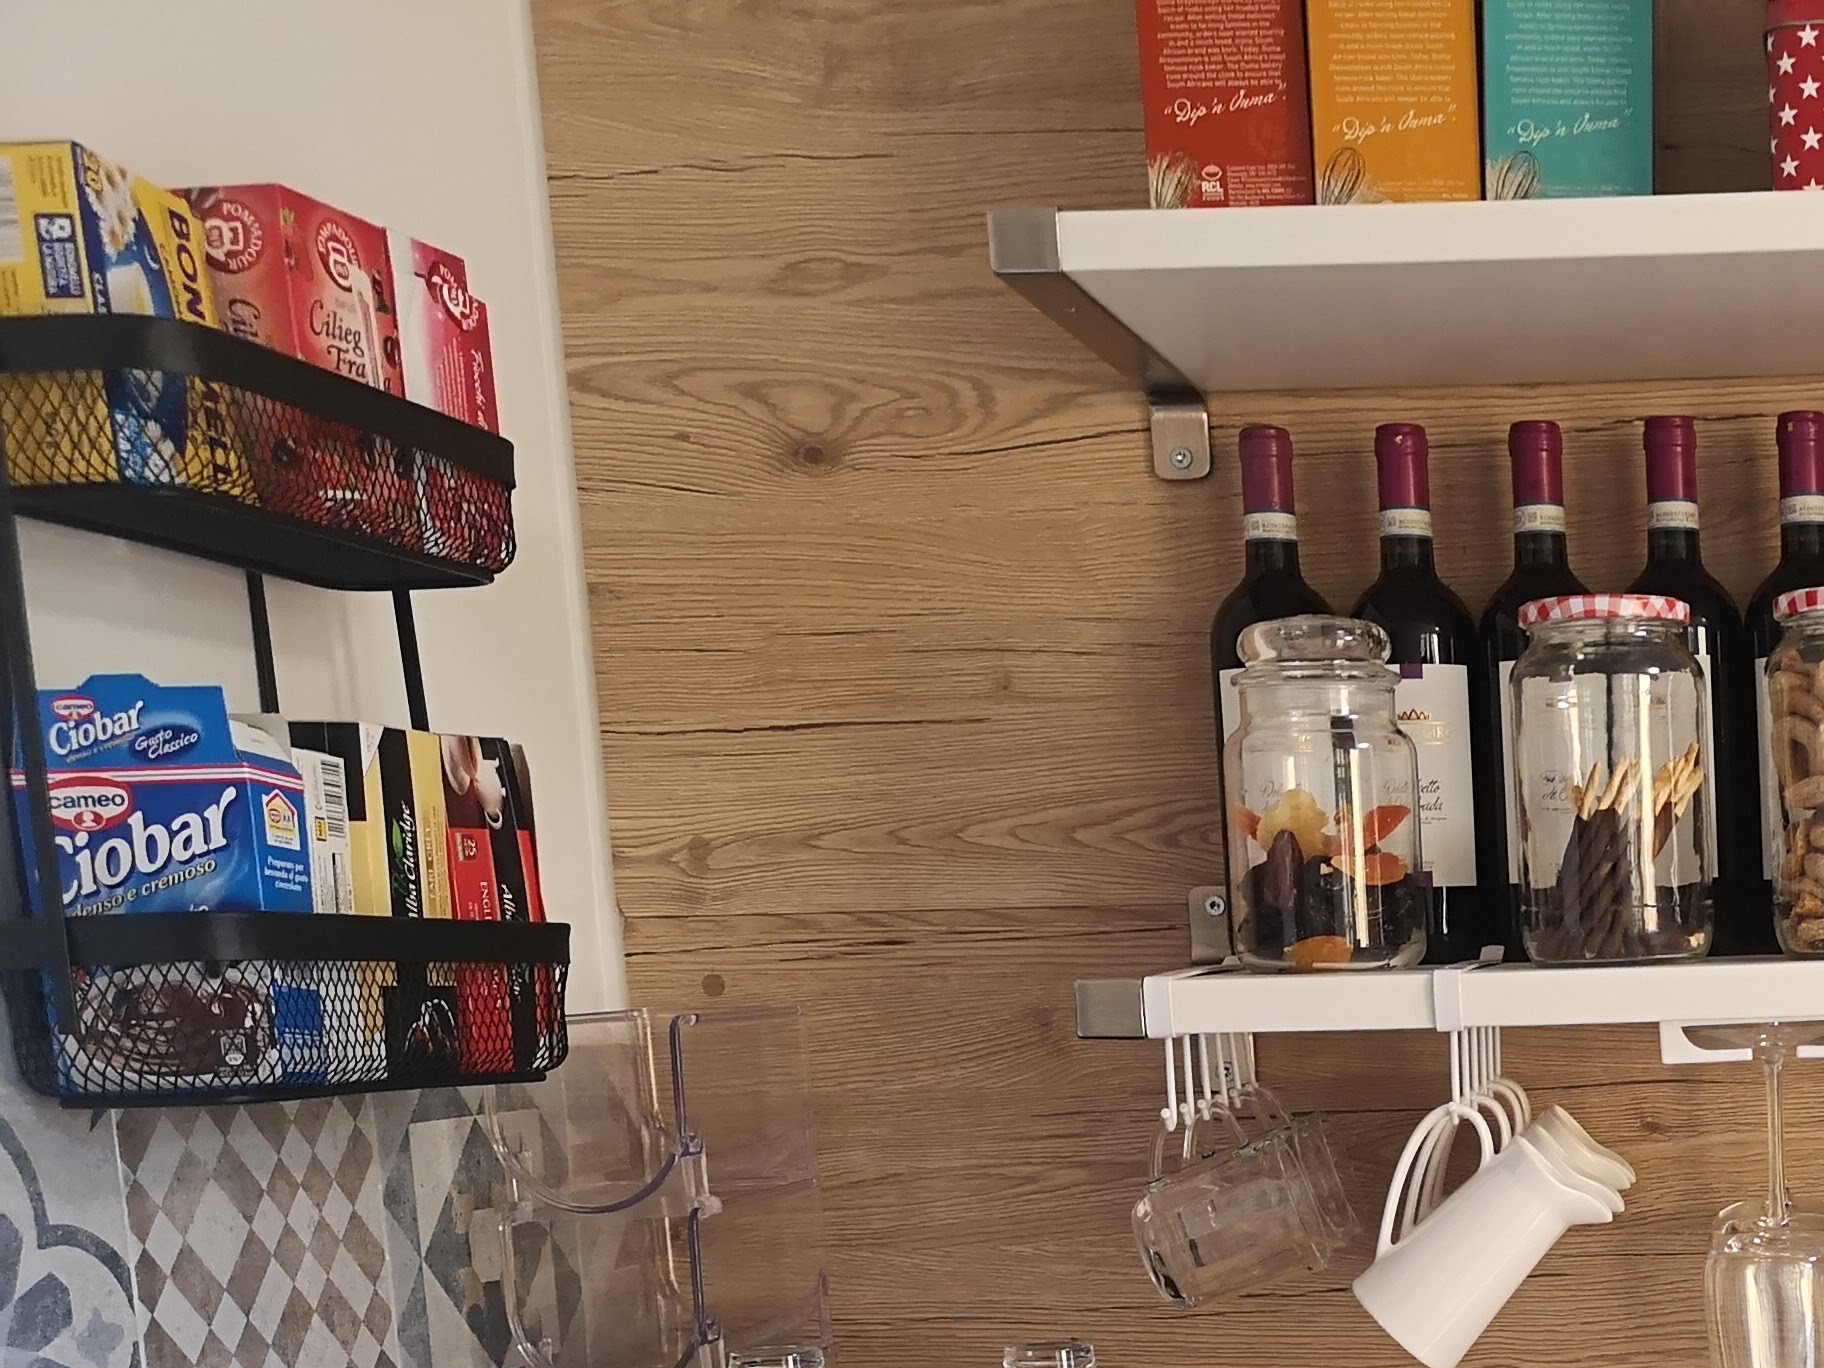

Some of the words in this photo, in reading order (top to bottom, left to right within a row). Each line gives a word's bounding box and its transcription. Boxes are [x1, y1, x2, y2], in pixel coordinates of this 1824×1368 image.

[1201, 180, 1224, 193] RCL
[49, 699, 144, 756] Ciobar
[134, 728, 173, 752] Gusto
[147, 730, 199, 760] Classico
[50, 792, 126, 810] cameo
[398, 799, 416, 880] Claridge
[127, 887, 138, 902] e
[141, 858, 217, 898] cremoso
